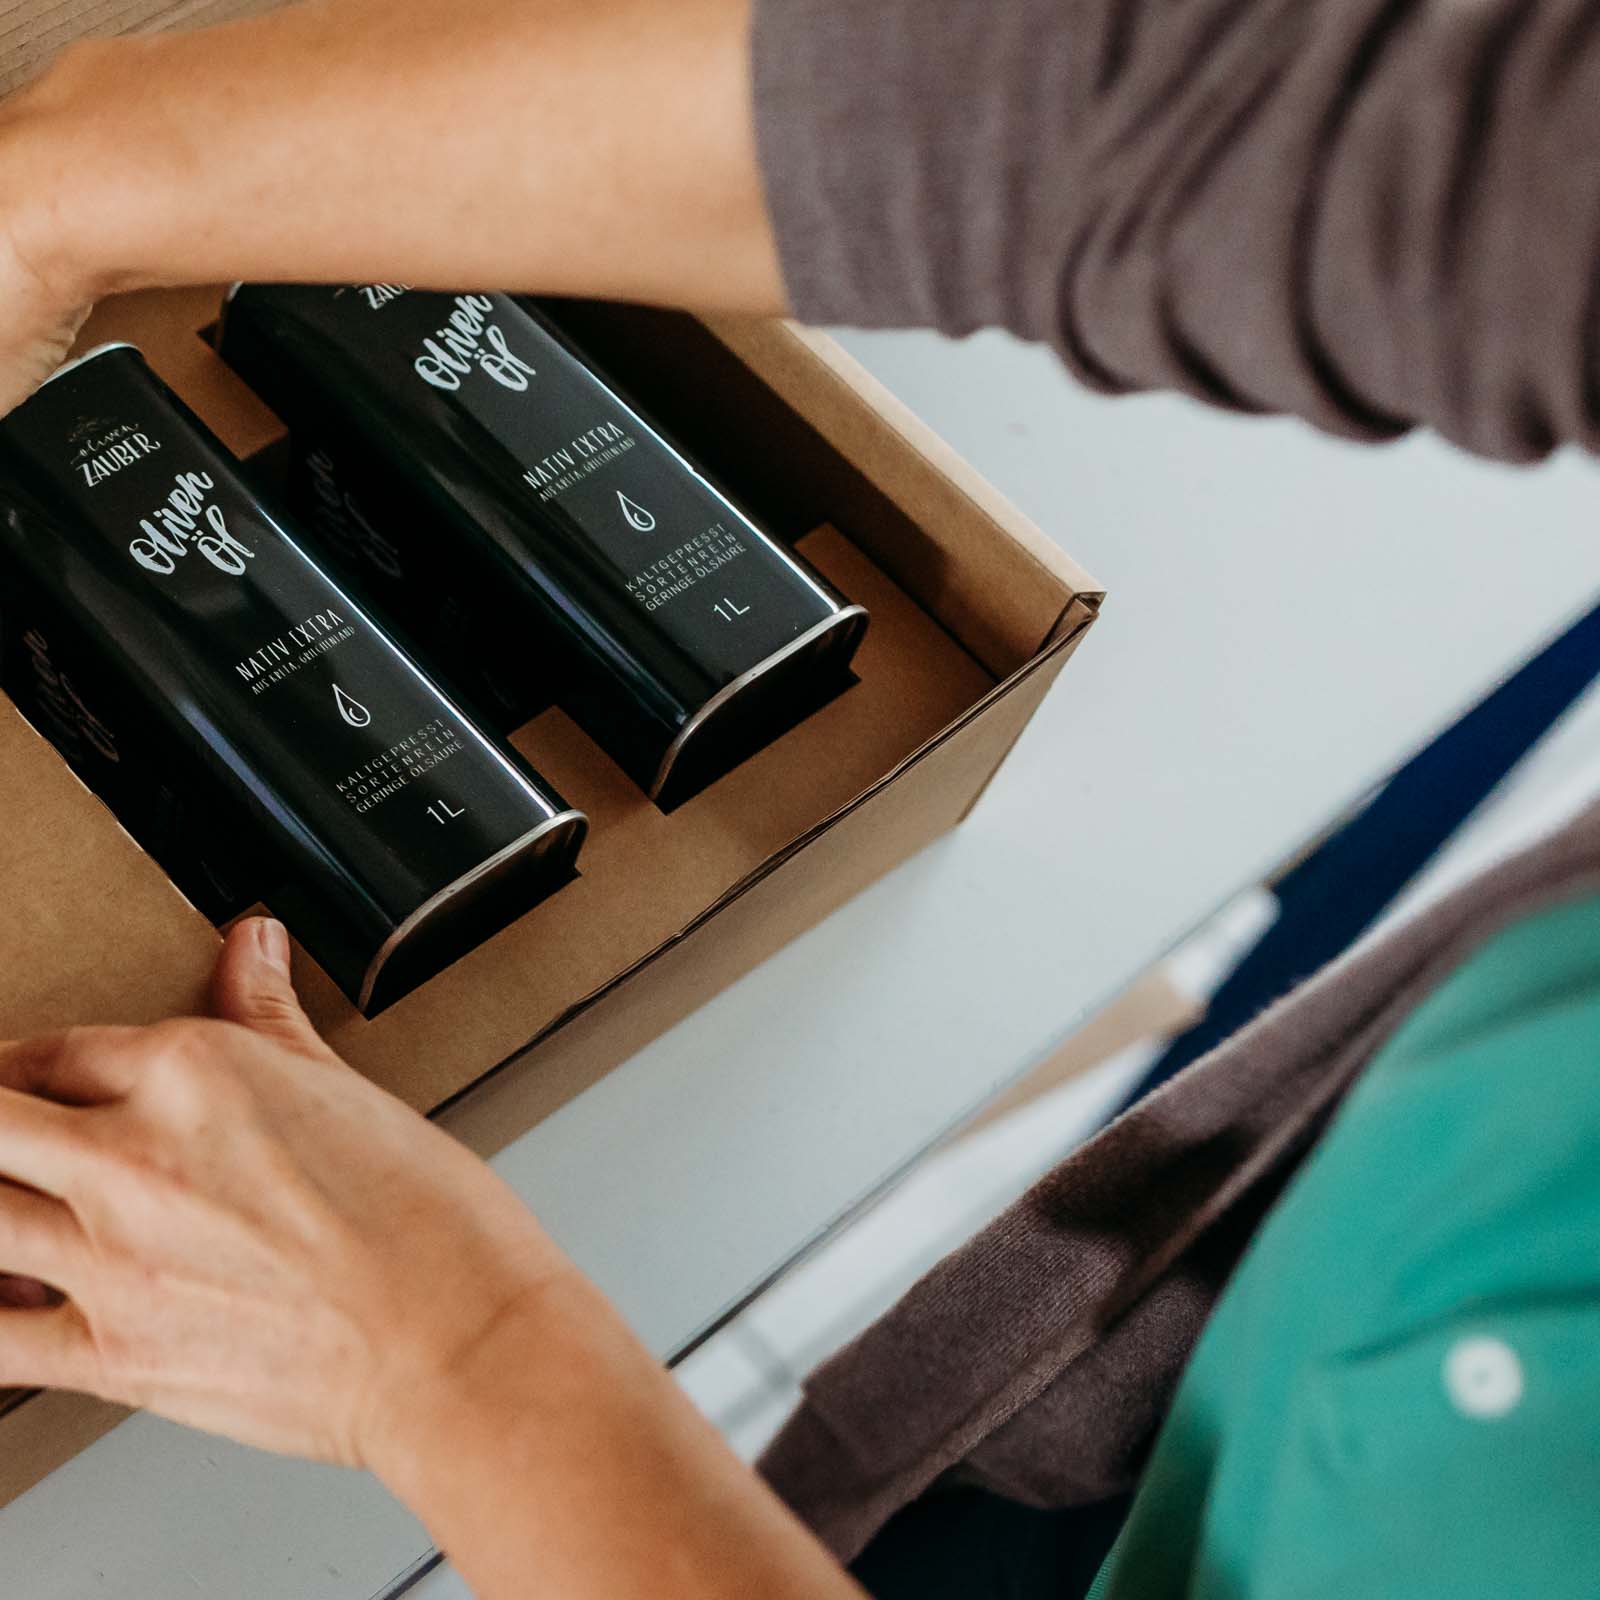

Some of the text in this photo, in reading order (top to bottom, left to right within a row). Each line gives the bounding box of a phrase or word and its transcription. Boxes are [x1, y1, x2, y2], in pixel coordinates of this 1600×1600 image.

[75, 432, 161, 488] ZAUBER
[522, 421, 625, 490] NATIV EXTRA
[624, 521, 726, 594] KALTGEPRESST
[634, 532, 738, 602] SORTENREIN
[645, 572, 698, 612] GERINGE
[712, 597, 751, 622] 1L
[235, 608, 344, 682] NATIV EXTRA
[251, 680, 270, 695] AUS
[336, 718, 445, 793] KALTGEPRESST
[345, 728, 456, 803] SORTENREIN
[355, 776, 412, 814] GERINGE
[426, 799, 465, 824] 1L
